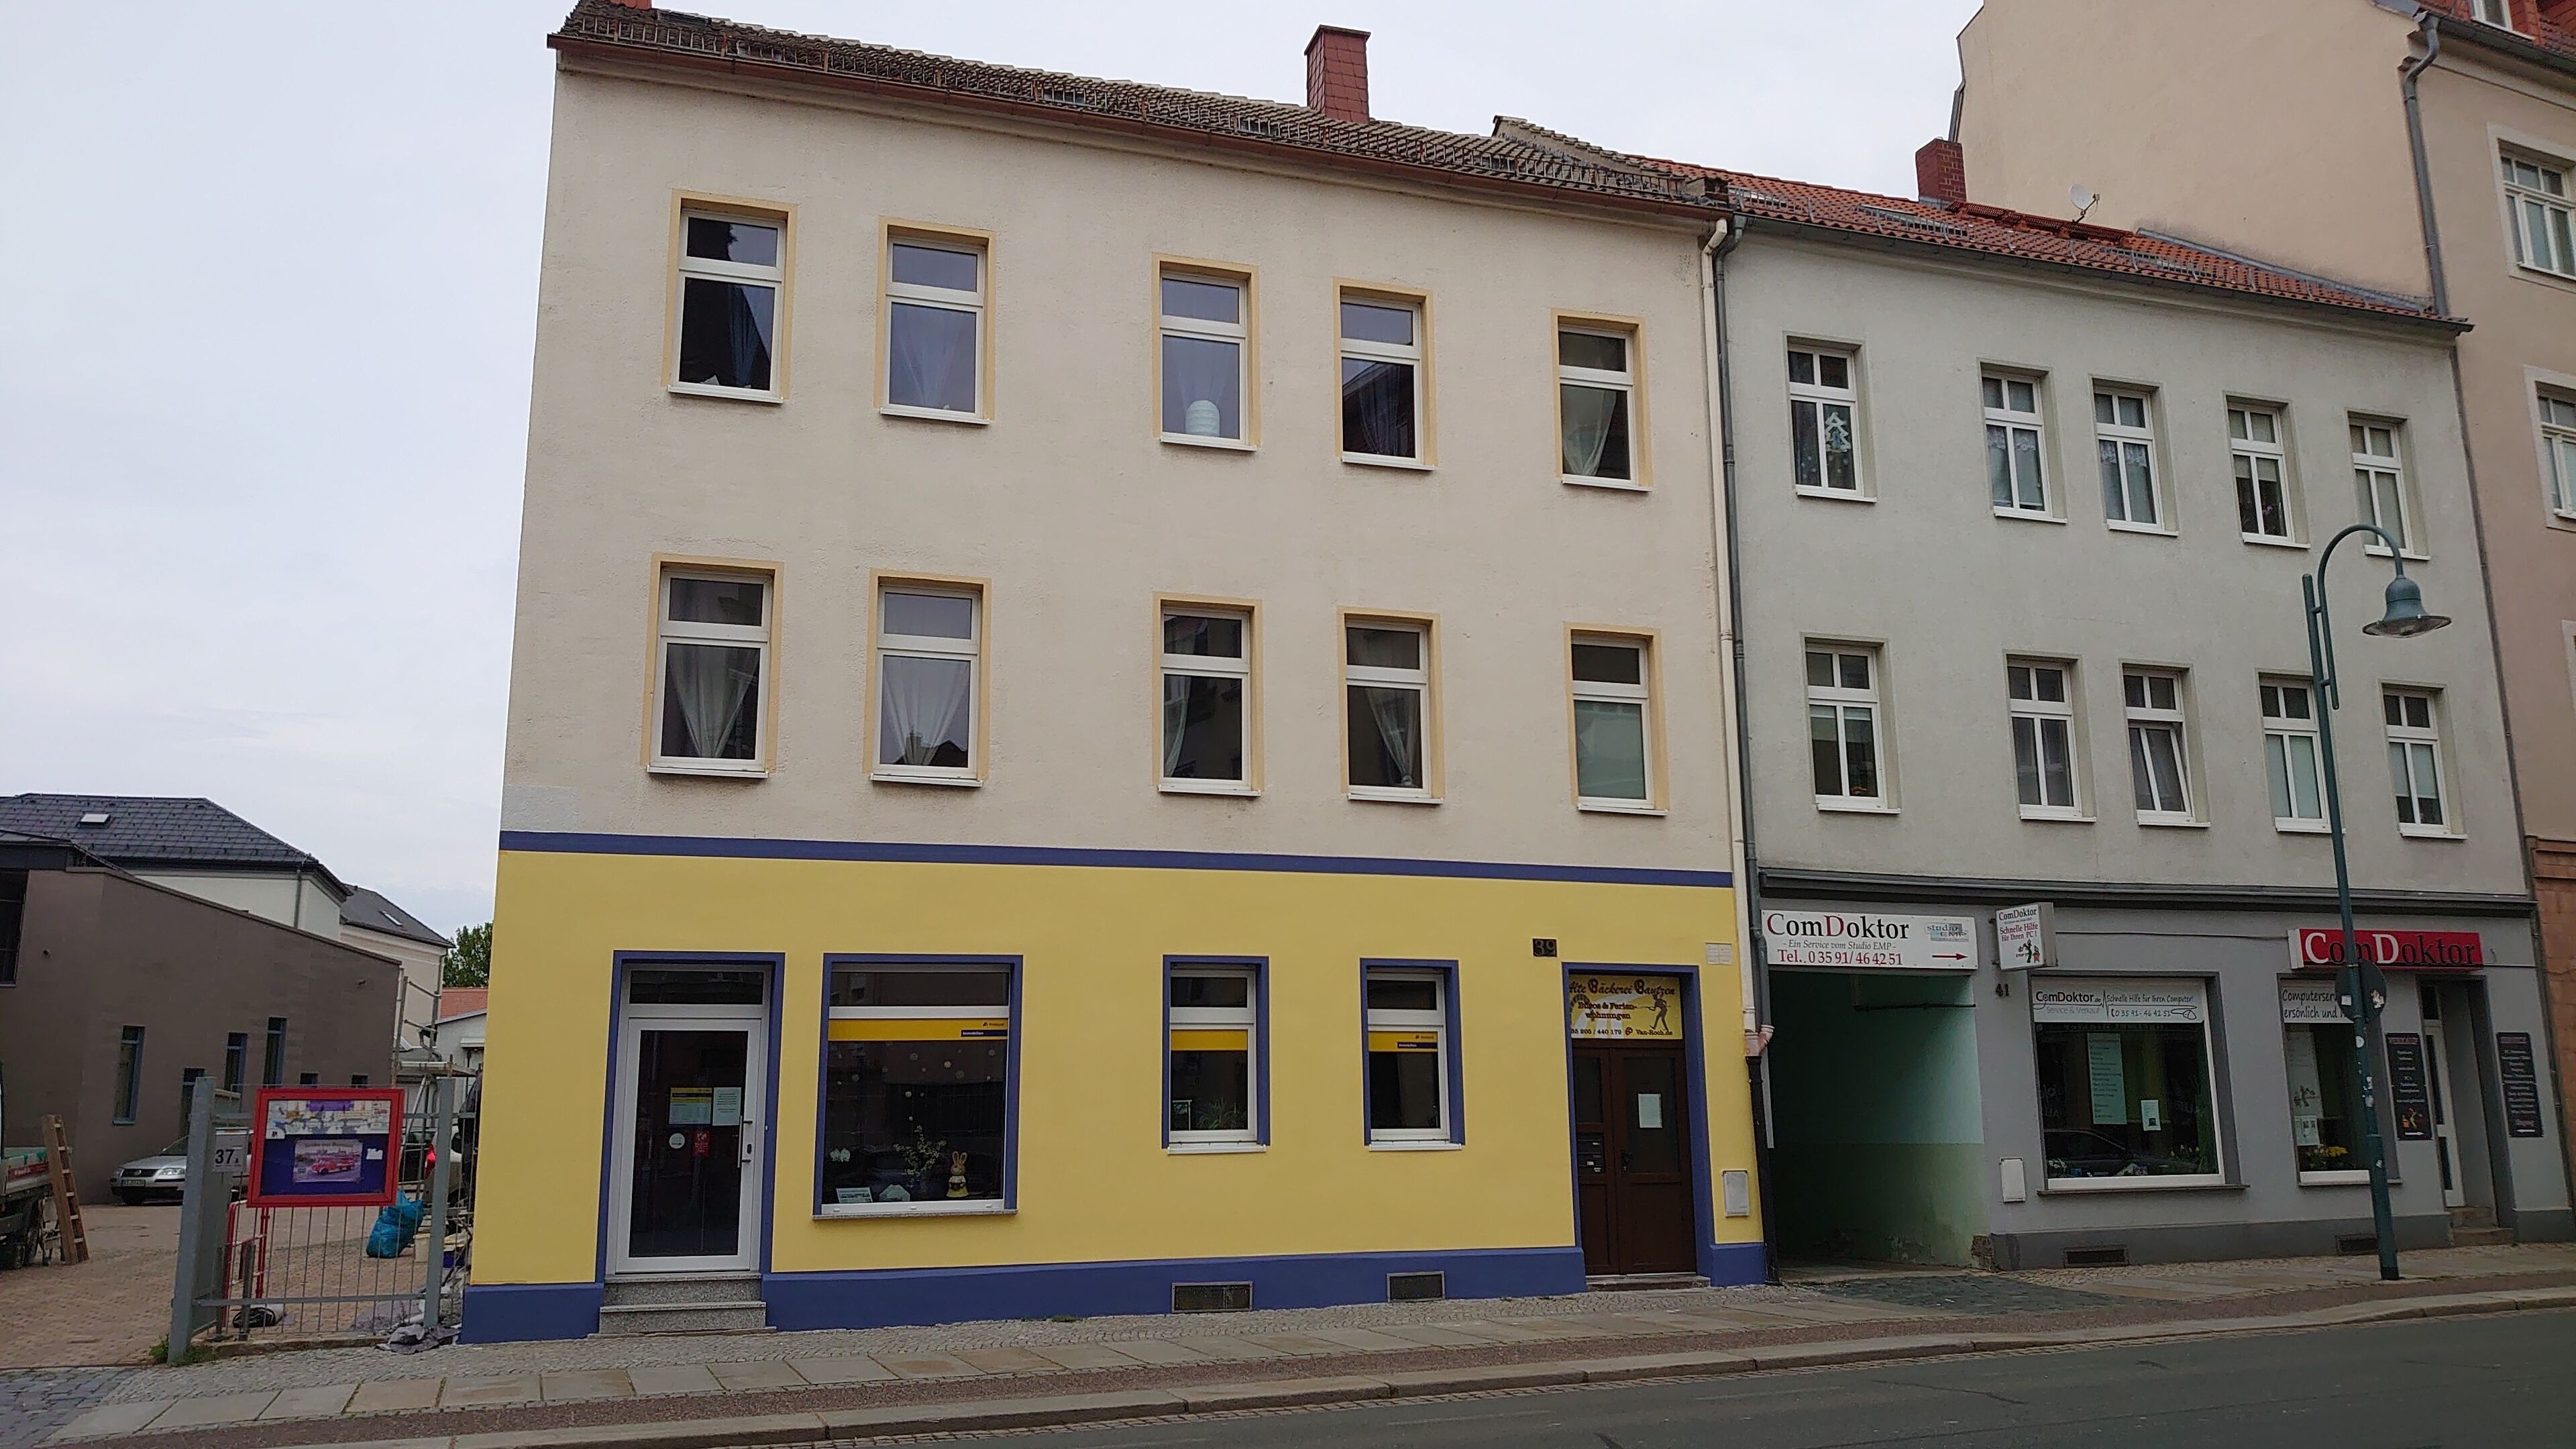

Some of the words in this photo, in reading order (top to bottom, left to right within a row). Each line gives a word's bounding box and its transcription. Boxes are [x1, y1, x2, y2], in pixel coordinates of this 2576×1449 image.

[1999, 908, 2037, 920] ComDoktor
[1767, 913, 1909, 939] ComDoktor
[2000, 925, 2023, 934] Schnelle
[2024, 922, 2039, 931] Hilfe
[1534, 939, 1556, 956] 39
[1788, 940, 1801, 948] Ein
[1803, 940, 1829, 949] Service
[1848, 941, 1871, 950] Studio
[1873, 941, 1892, 950] EMP
[2305, 932, 2475, 965] ComDoktor
[1588, 978, 1633, 994] Bäckerei
[1634, 979, 1675, 996] Bautzen
[1995, 983, 2009, 997] 41
[2106, 994, 2128, 1002] Schnelle
[2129, 994, 2141, 1002] Hilfe
[2142, 994, 2151, 1002] für
[2151, 994, 2165, 1002] Ihren
[2167, 994, 2194, 1005] Computer!
[2282, 989, 2338, 1006] Computerser
[1578, 1002, 1601, 1010] Büros
[2322, 1006, 2338, 1018] und
[1585, 1011, 1631, 1020] wohnungen
